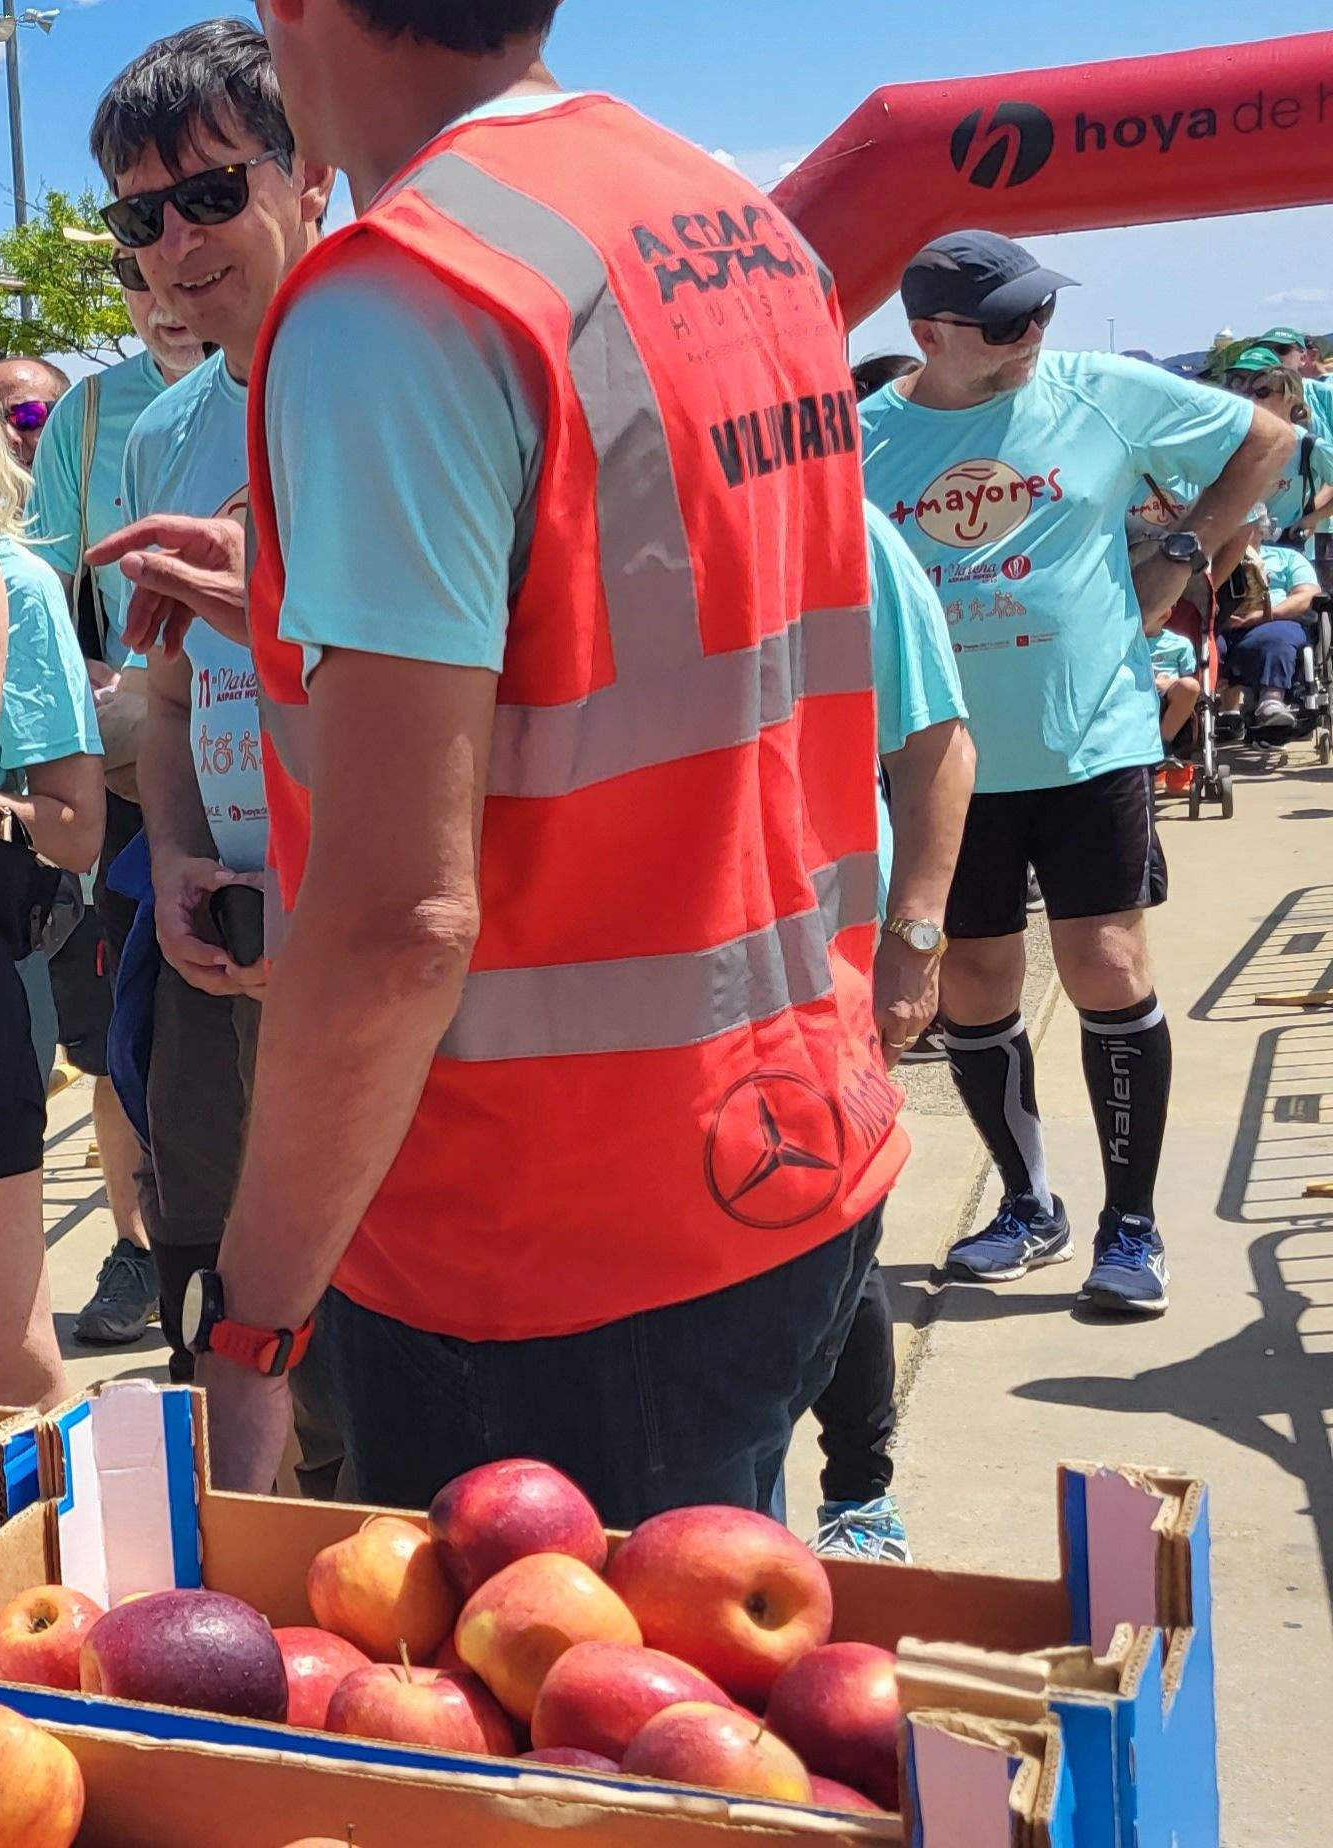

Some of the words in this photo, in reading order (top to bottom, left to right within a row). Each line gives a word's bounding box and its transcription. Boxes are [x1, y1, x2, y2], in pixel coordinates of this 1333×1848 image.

[1075, 107, 1217, 153] hoya
[1233, 89, 1301, 133] de
[1100, 1037, 1142, 1166] Kalenji
